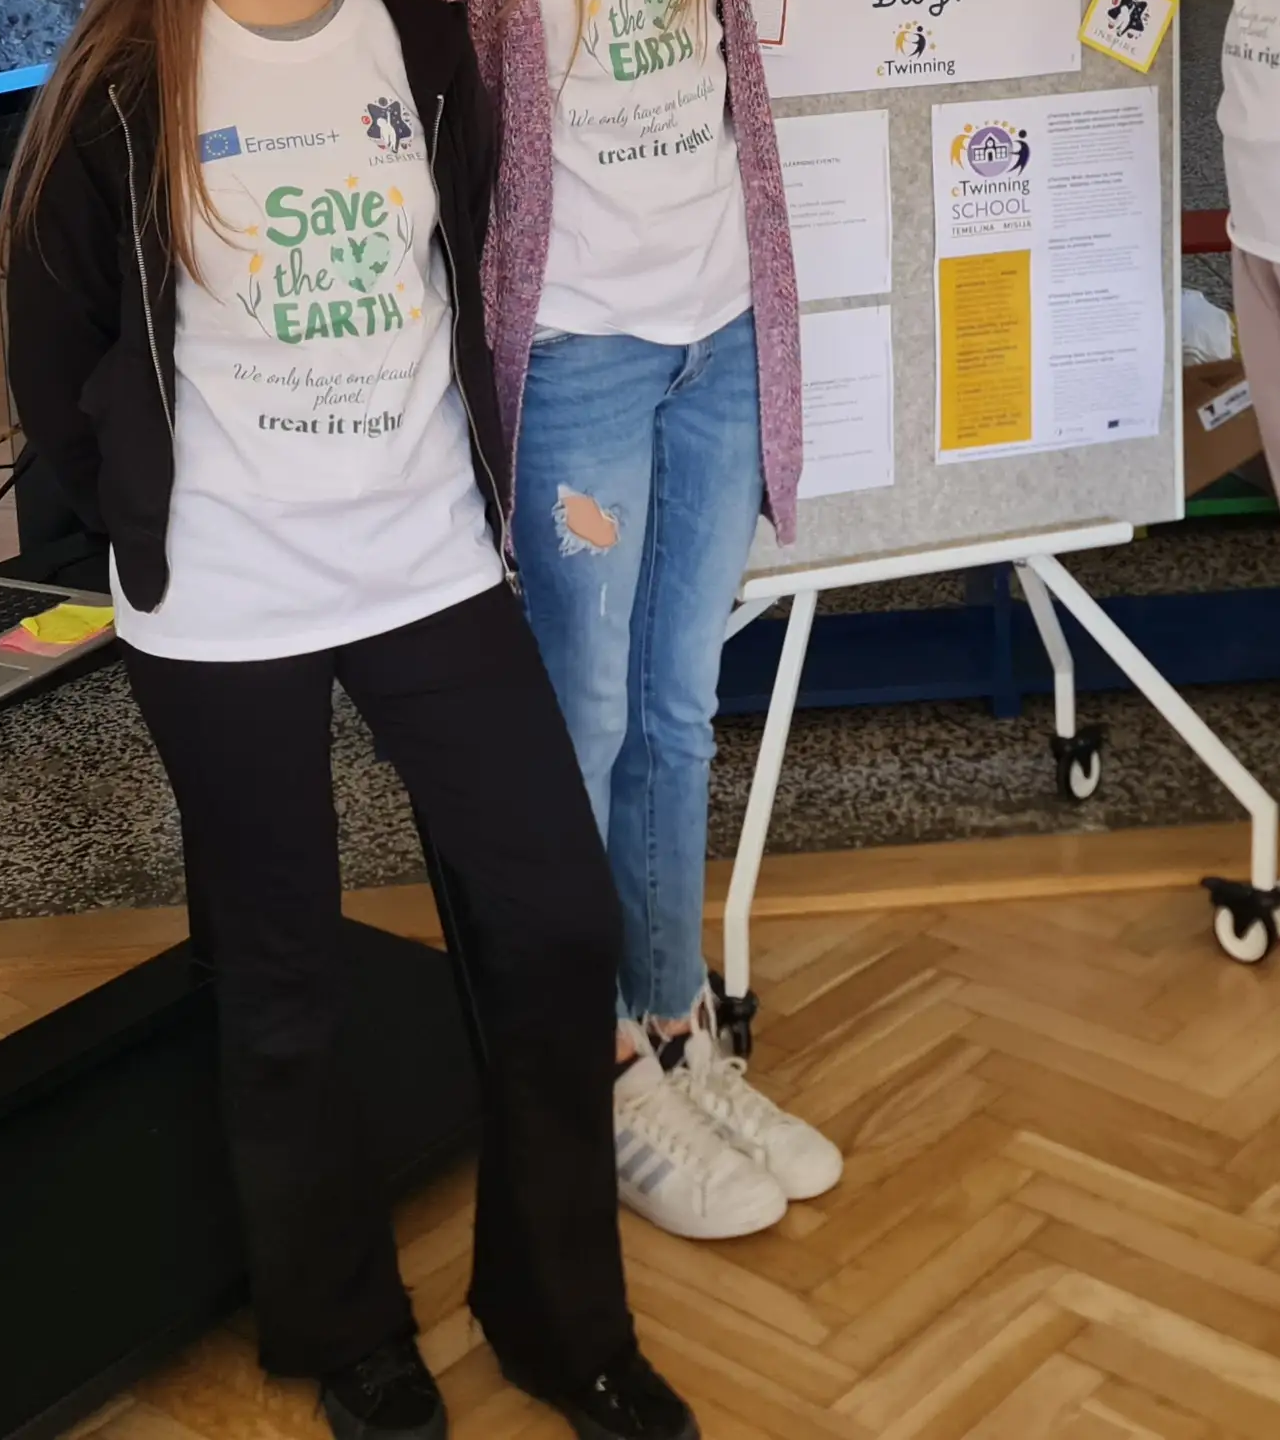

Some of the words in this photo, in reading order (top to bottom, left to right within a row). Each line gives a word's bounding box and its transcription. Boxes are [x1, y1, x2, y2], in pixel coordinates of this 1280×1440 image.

[608, 27, 694, 82] EARTH
[876, 56, 956, 78] eTwinning
[244, 128, 341, 155] Erasmus+
[598, 143, 647, 166] treat
[653, 139, 669, 157] it
[675, 122, 714, 155] right!
[951, 176, 1031, 198] eTwinning
[264, 185, 389, 248] Save
[951, 196, 1032, 221] SCHOOL
[273, 247, 334, 299] the
[273, 291, 404, 345] EARTH
[232, 362, 262, 383] We
[266, 366, 301, 392] only
[305, 367, 343, 389] have
[258, 412, 321, 435] treat
[328, 413, 345, 435] it
